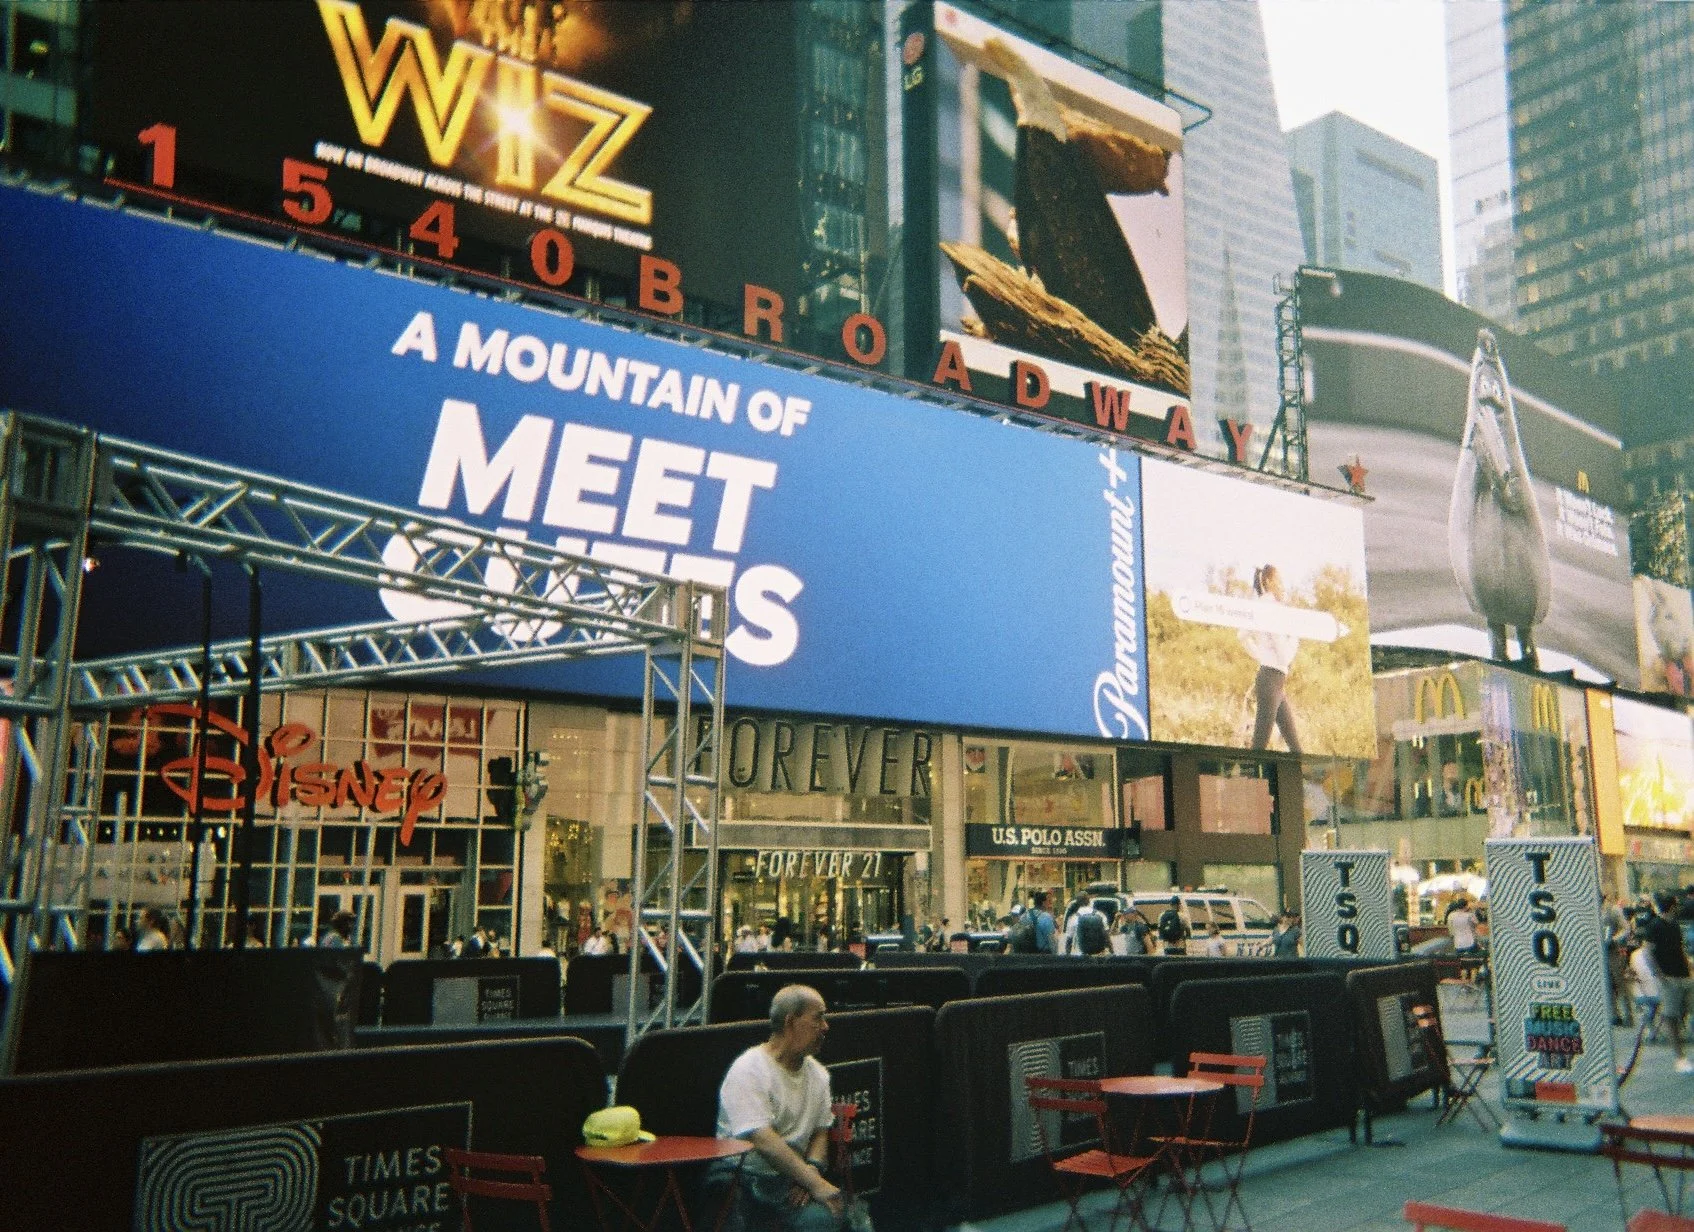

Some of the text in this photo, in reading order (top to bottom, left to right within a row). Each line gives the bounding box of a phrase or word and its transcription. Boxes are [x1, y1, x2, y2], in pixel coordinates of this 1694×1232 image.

[315, 0, 653, 225] WIZ
[138, 122, 1253, 462] 1540 BROADWAY
[391, 311, 812, 436] A MOUNTAIN OF
[418, 398, 778, 553] MEET
[694, 714, 933, 797] FOREVER
[754, 851, 882, 878] FOREVER 21
[991, 827, 1106, 847] U.S. POLO ASSN.
[1333, 861, 1360, 954] TSQ
[1524, 852, 1560, 968] TSQ
[1527, 1035, 1583, 1053] DANCE
[1531, 1003, 1574, 1020] FREE
[328, 1182, 451, 1228] SQUARE
[344, 1145, 442, 1184] TIMES
